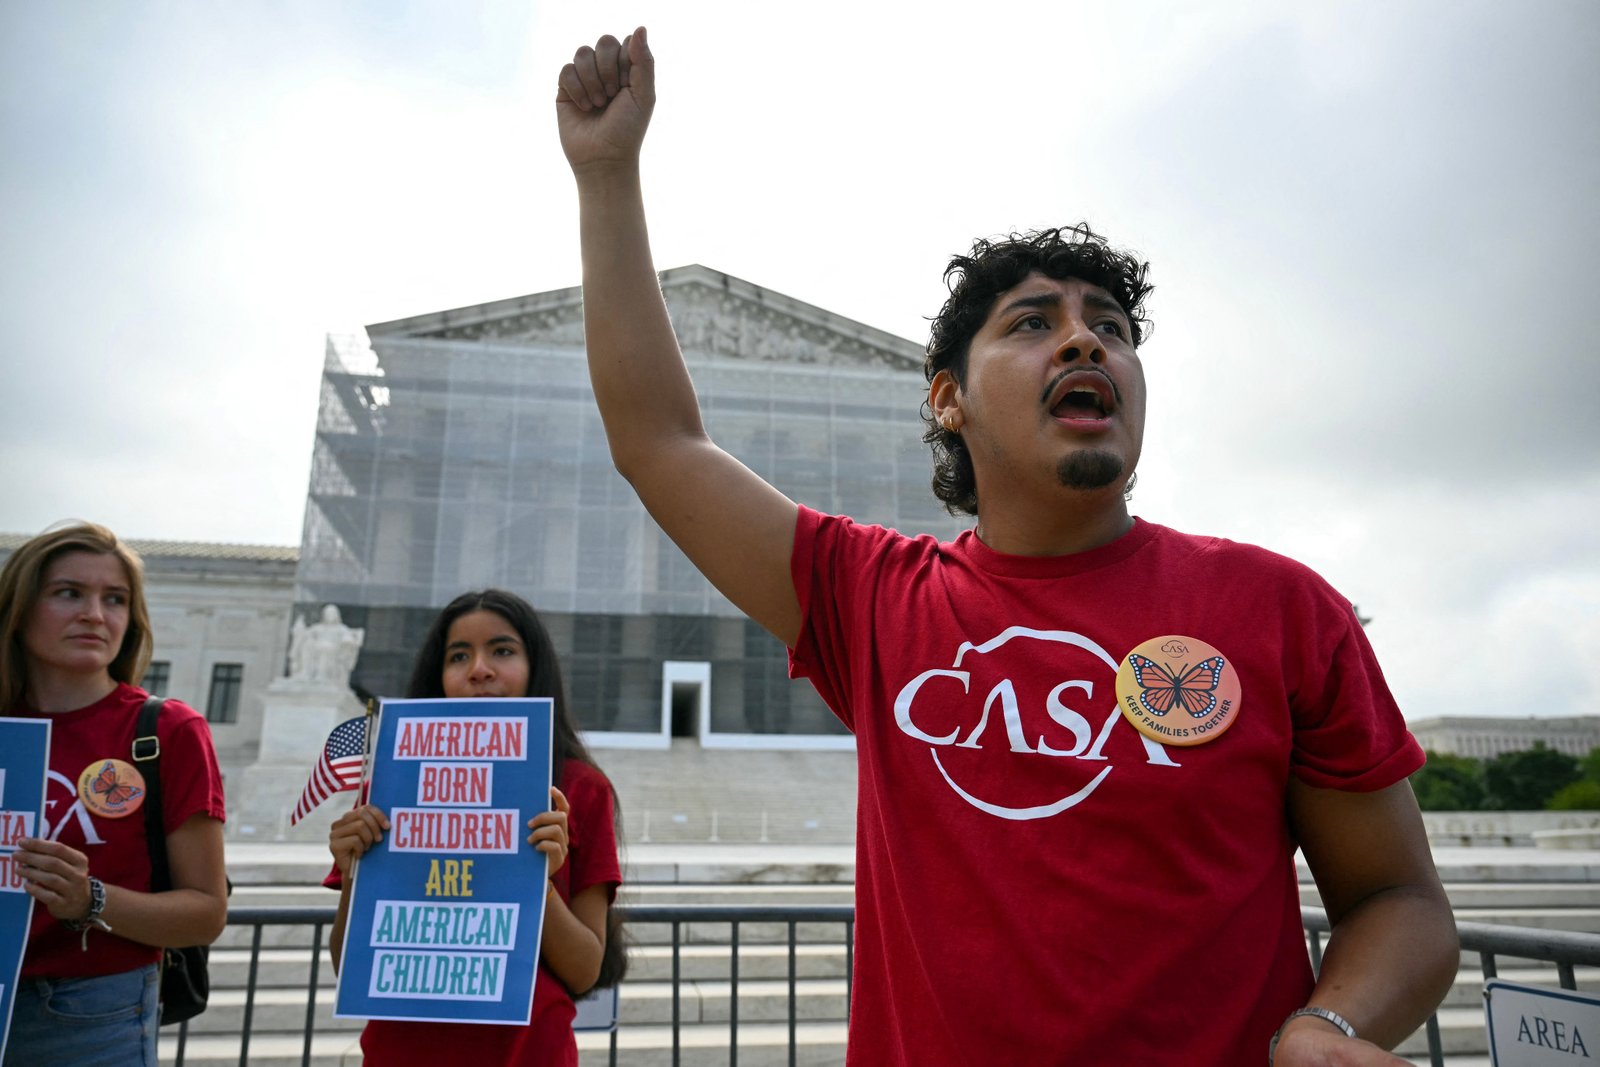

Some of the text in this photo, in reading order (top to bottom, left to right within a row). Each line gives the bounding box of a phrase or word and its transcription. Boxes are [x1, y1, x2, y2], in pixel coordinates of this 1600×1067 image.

[1161, 643, 1190, 654] CASA
[1125, 695, 1232, 737] KEEP FAMILIES TOGETHER
[398, 721, 523, 758] AMERICAN
[422, 766, 489, 804] BORN
[394, 811, 513, 850] CHILDREN
[425, 859, 474, 897] ARE
[376, 905, 514, 947] AMERICAN
[375, 953, 502, 996] CHILDREN
[1517, 1014, 1590, 1058] AREA
